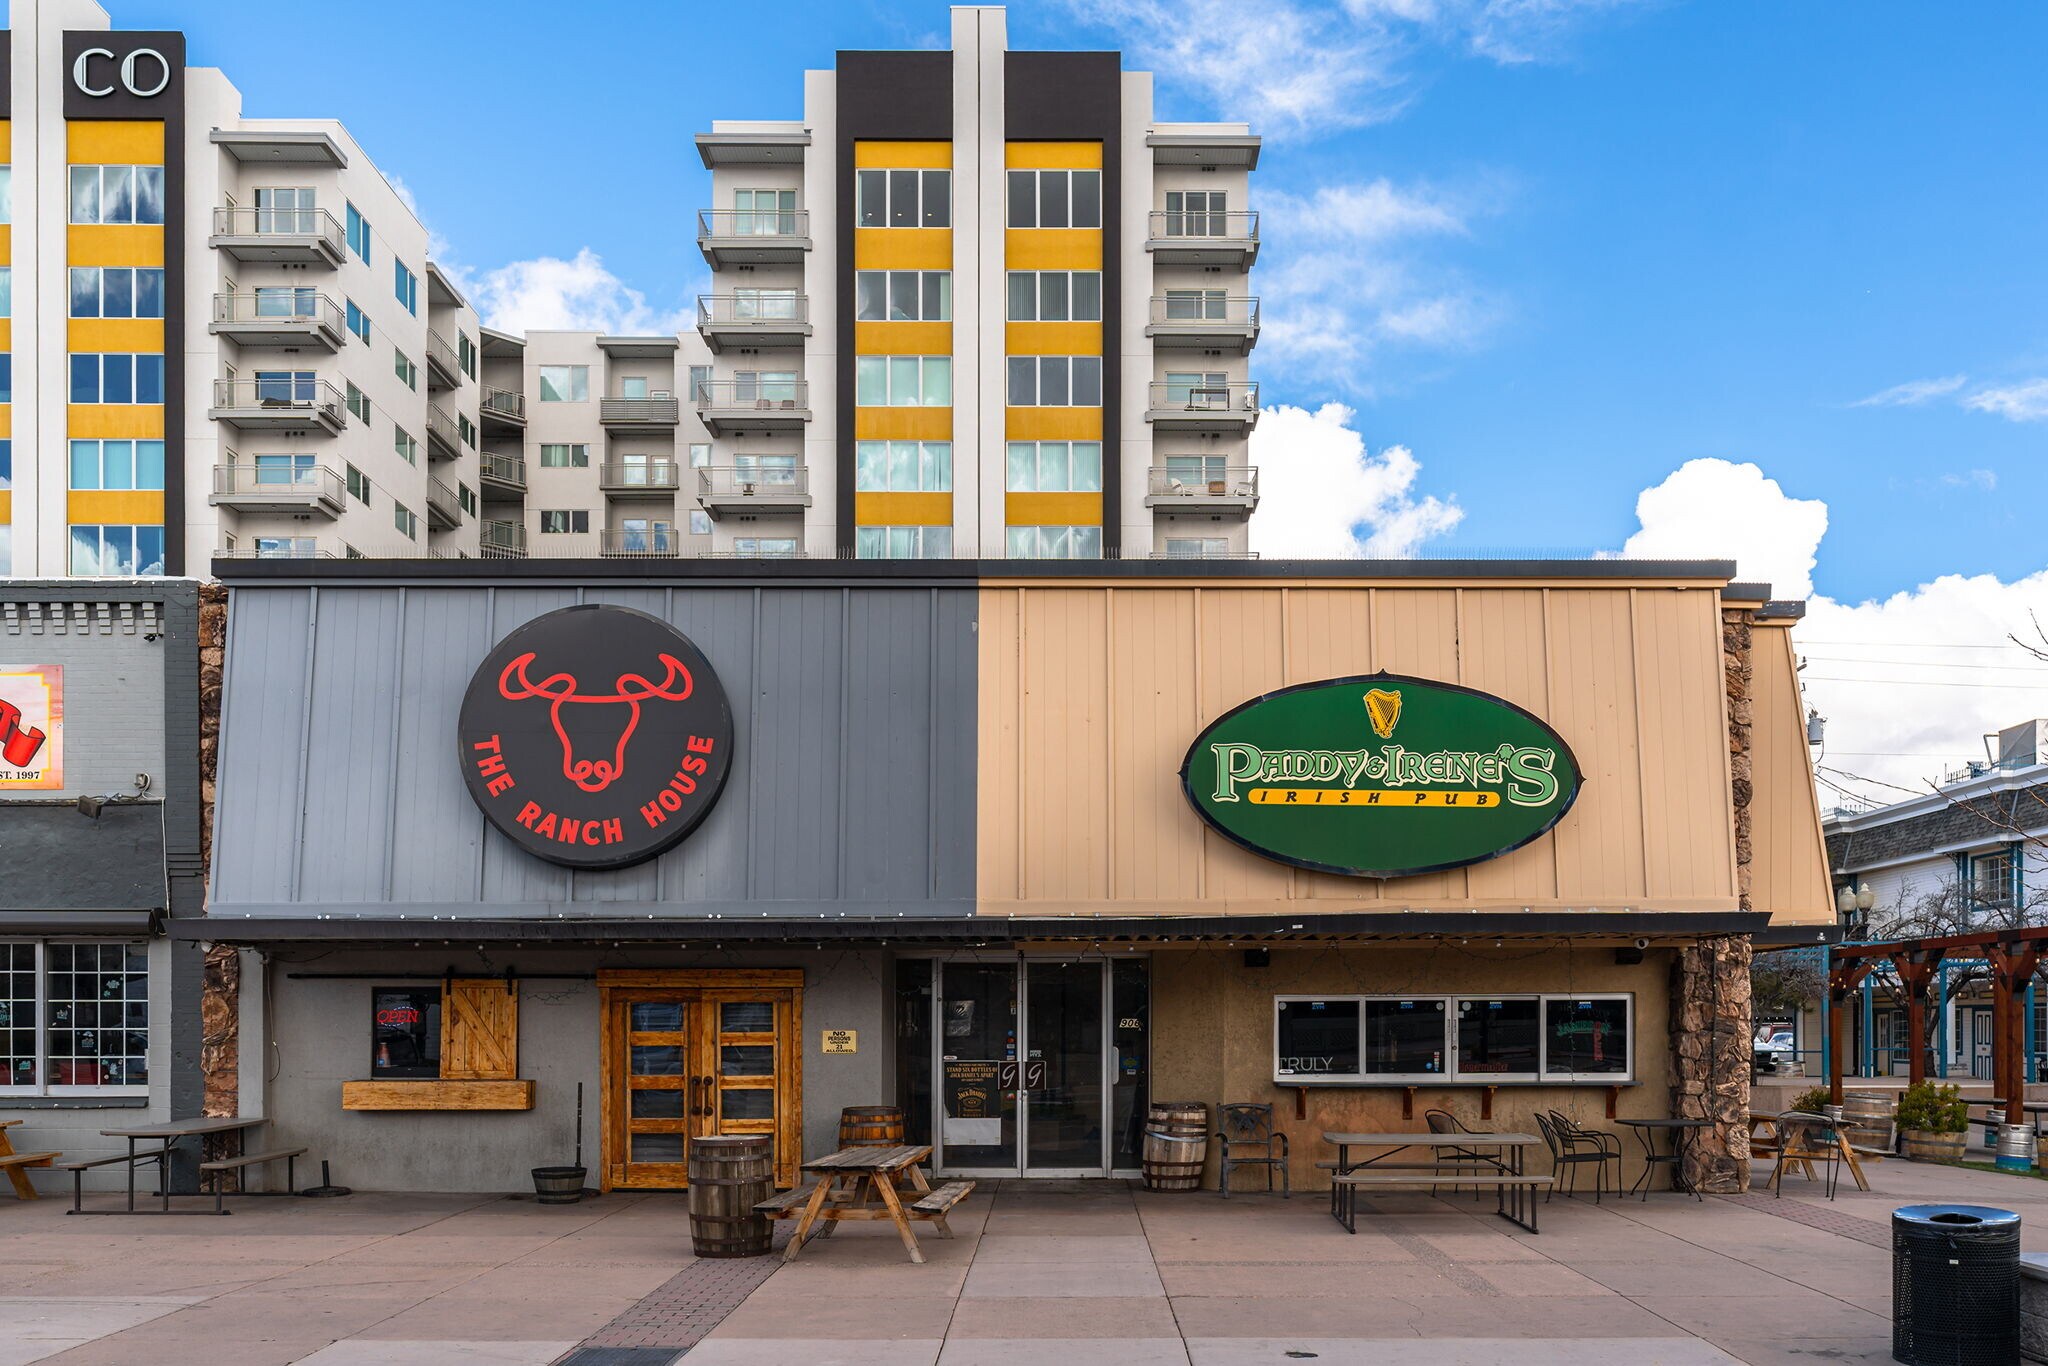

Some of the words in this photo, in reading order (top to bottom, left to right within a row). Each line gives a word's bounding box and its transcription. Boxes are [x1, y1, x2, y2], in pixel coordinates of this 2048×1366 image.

[73, 47, 171, 97] CO
[16, 771, 40, 780] 1997
[474, 734, 516, 798] THE
[515, 800, 624, 846] RANCH
[639, 735, 715, 829] HOUSE
[1259, 790, 1381, 804] IRISH
[1414, 792, 1489, 806] PUB
[376, 1009, 419, 1023] OPEN
[1279, 1056, 1334, 1071] TRULY
